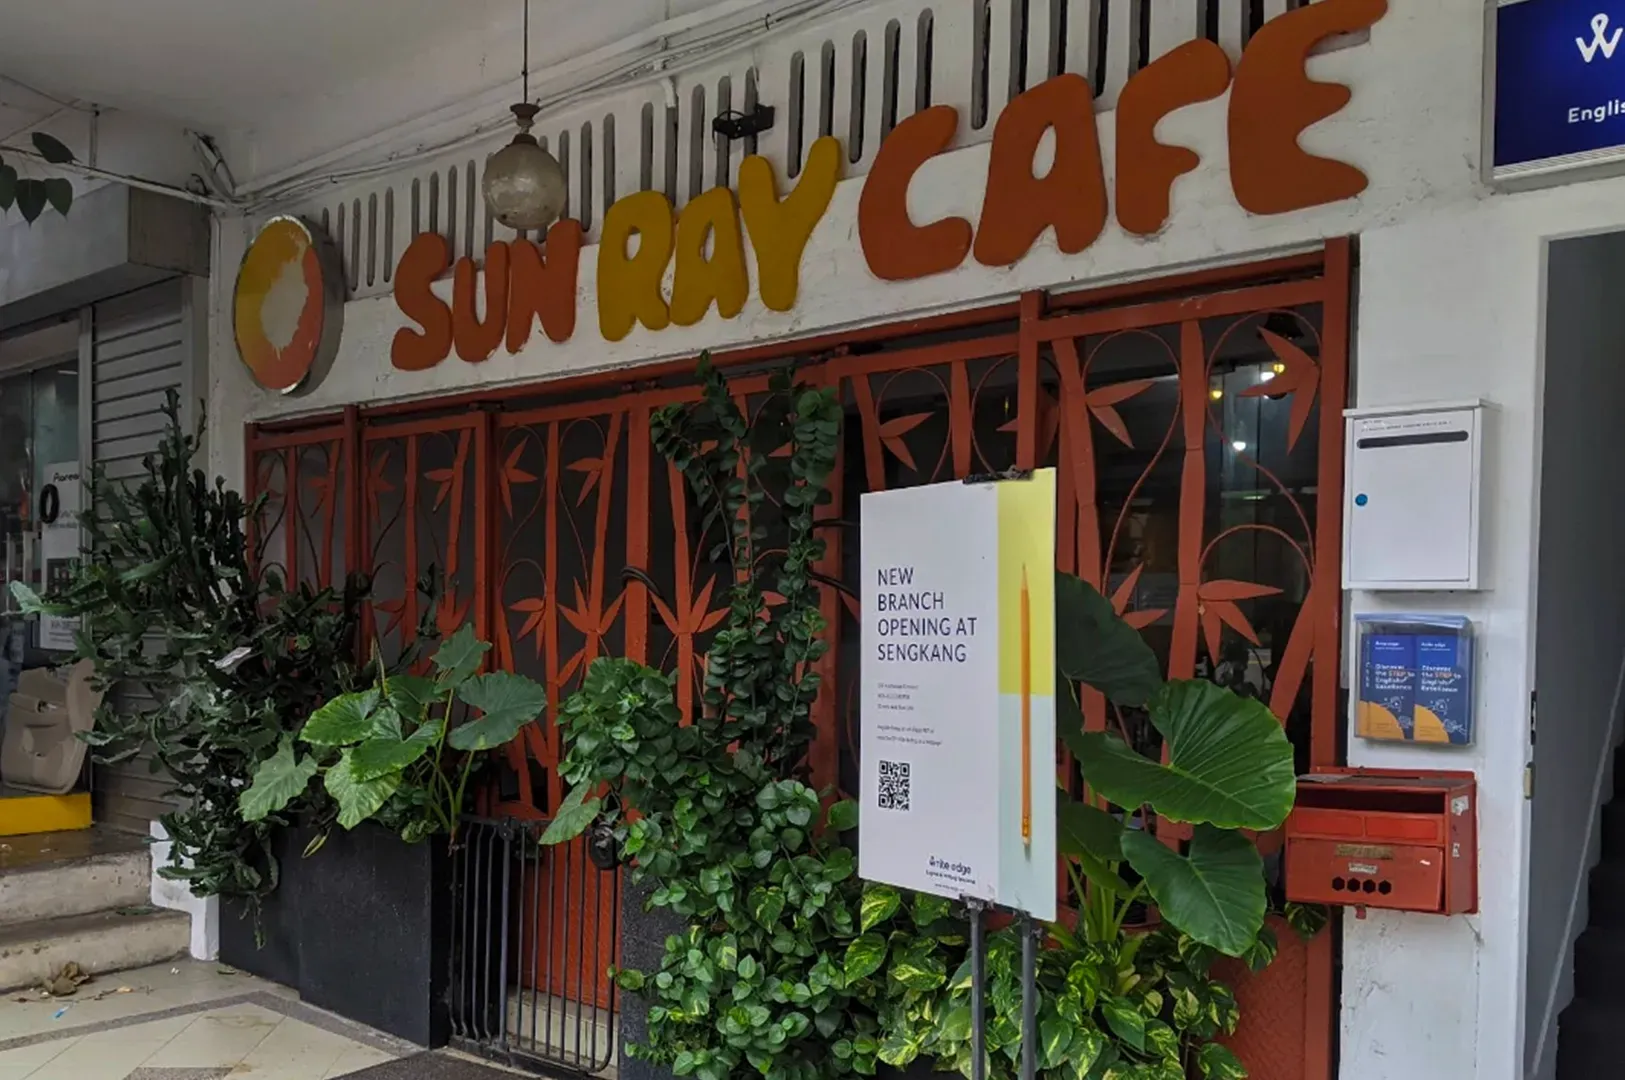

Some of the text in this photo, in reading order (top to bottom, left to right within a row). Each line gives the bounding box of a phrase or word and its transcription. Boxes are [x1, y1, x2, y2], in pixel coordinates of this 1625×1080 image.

[391, 0, 1387, 371] SUN RAY CAFE
[877, 566, 914, 586] NEW
[877, 591, 945, 612] BRANCH
[877, 617, 978, 636] OPENING AT
[877, 643, 967, 662] SENGKANG
